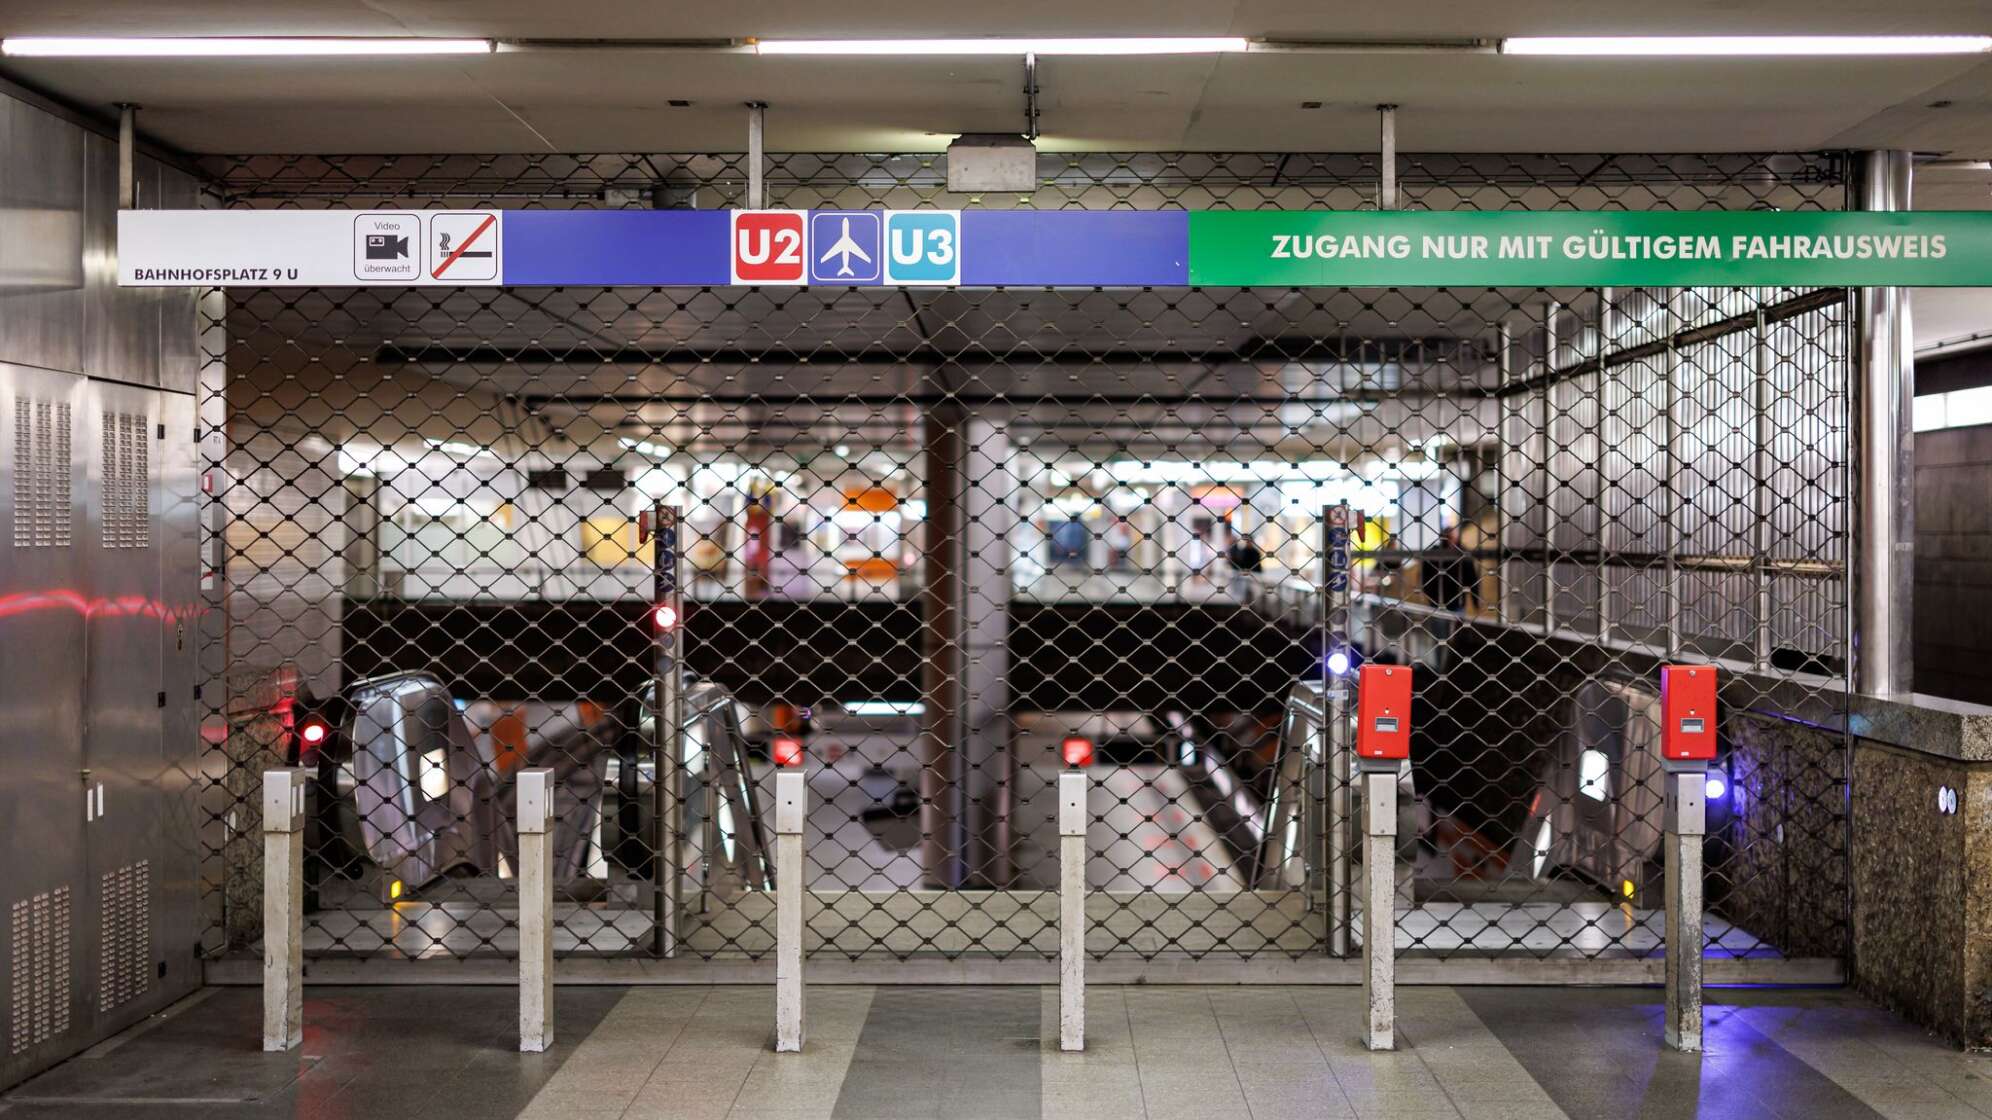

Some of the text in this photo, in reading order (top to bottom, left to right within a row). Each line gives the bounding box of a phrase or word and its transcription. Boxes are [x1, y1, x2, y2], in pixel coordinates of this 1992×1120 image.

[374, 222, 400, 230] Video
[739, 229, 801, 264] U2
[892, 229, 953, 265] U3
[1271, 229, 1947, 260] ZUGANG NUR MIT GÜLTIGEM FAHRAUSWEIS
[135, 269, 298, 281] BAHNHOFSPLATZ 9 U
[364, 264, 411, 273] überwacht
